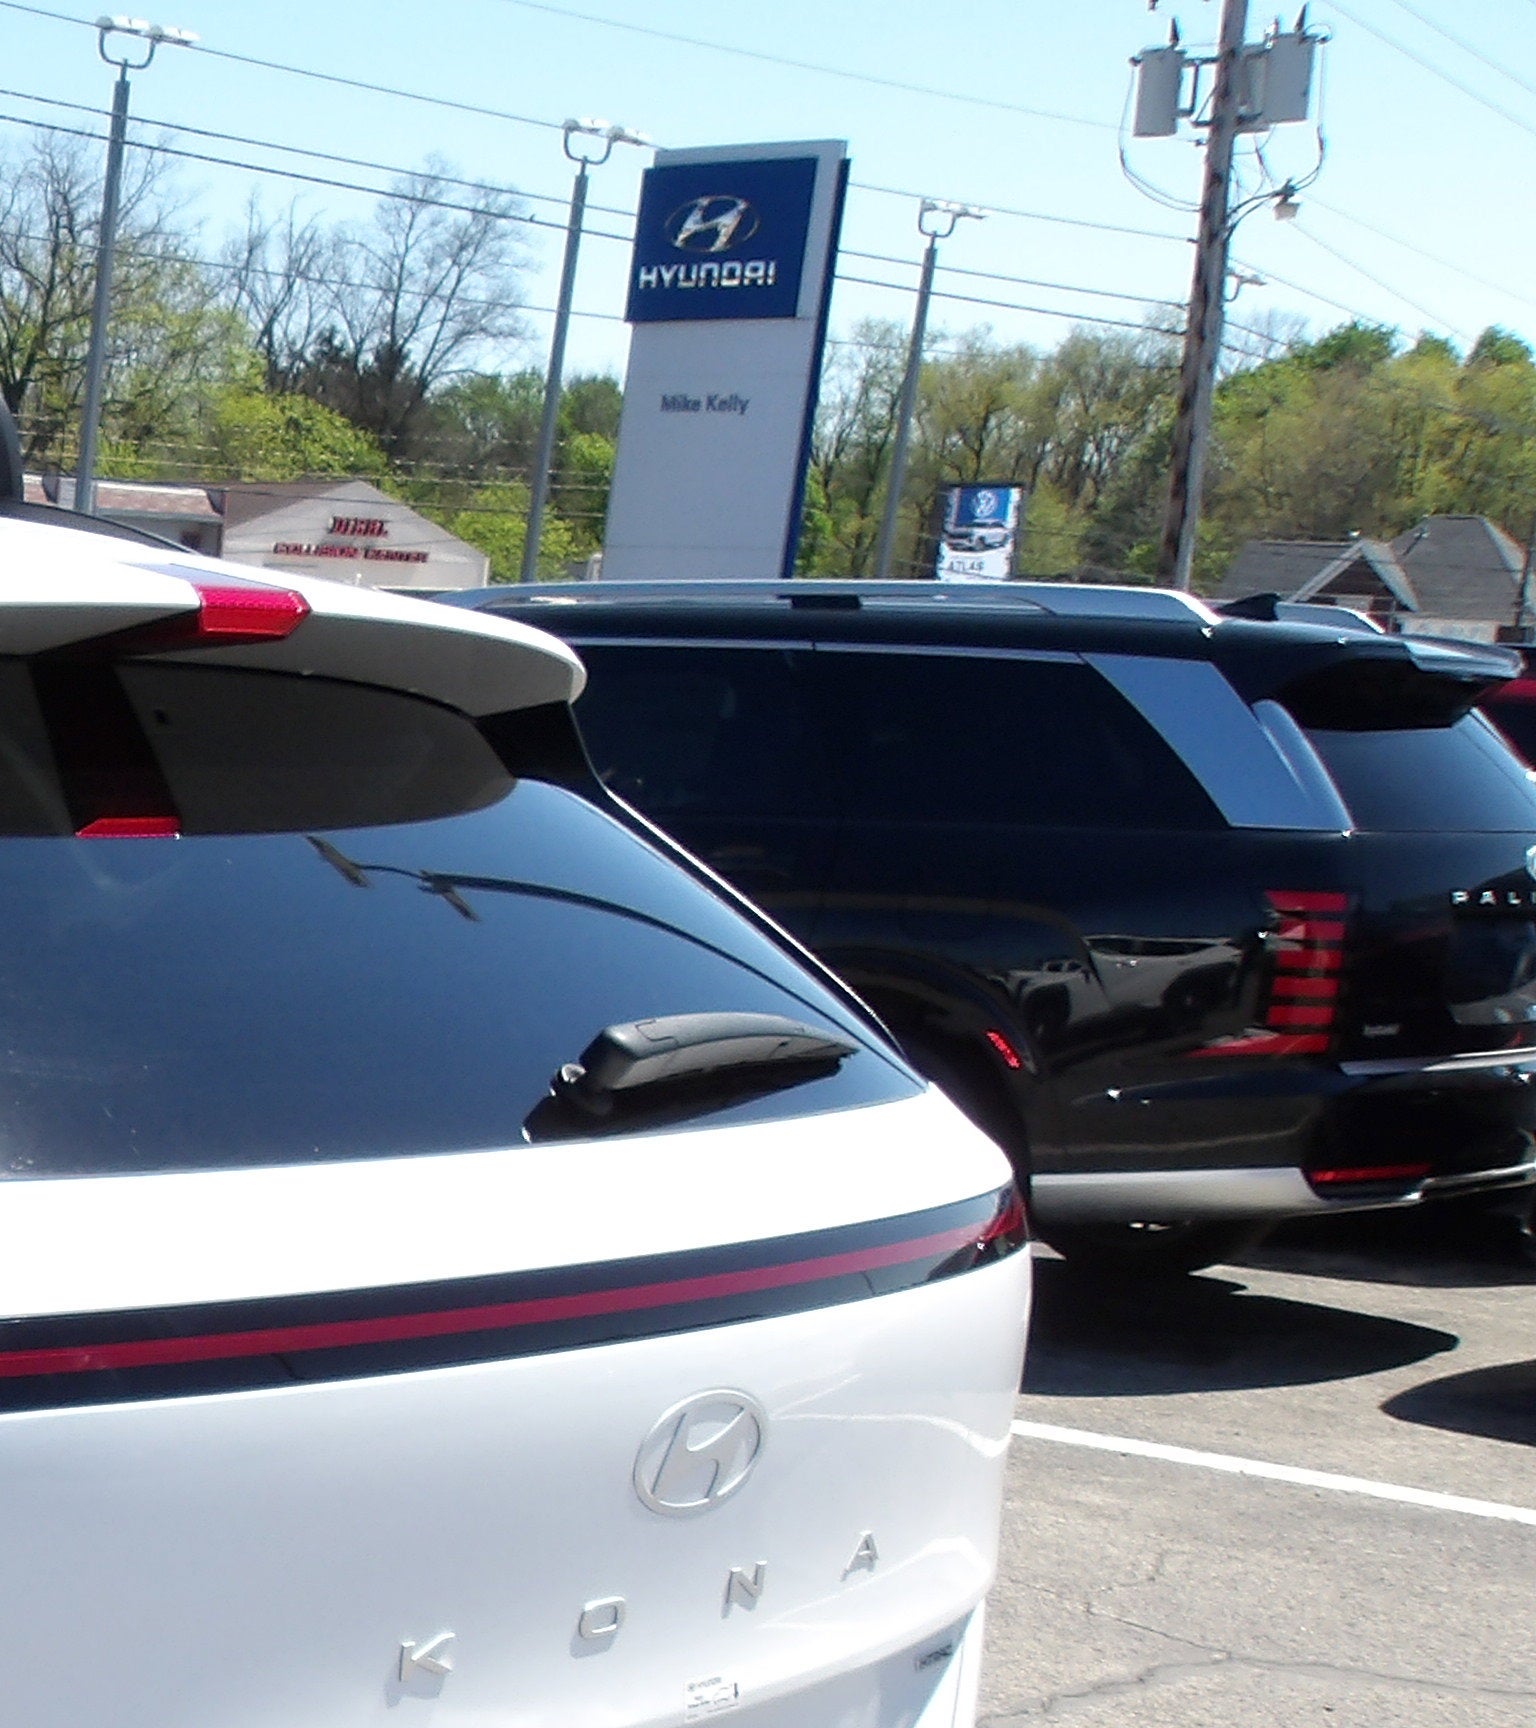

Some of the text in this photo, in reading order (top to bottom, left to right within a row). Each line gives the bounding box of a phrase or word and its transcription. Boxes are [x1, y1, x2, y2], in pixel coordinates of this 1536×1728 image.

[638, 259, 777, 289] HYUNDAI
[660, 392, 750, 415] Mike Kelly
[399, 1529, 879, 1683] KONA
